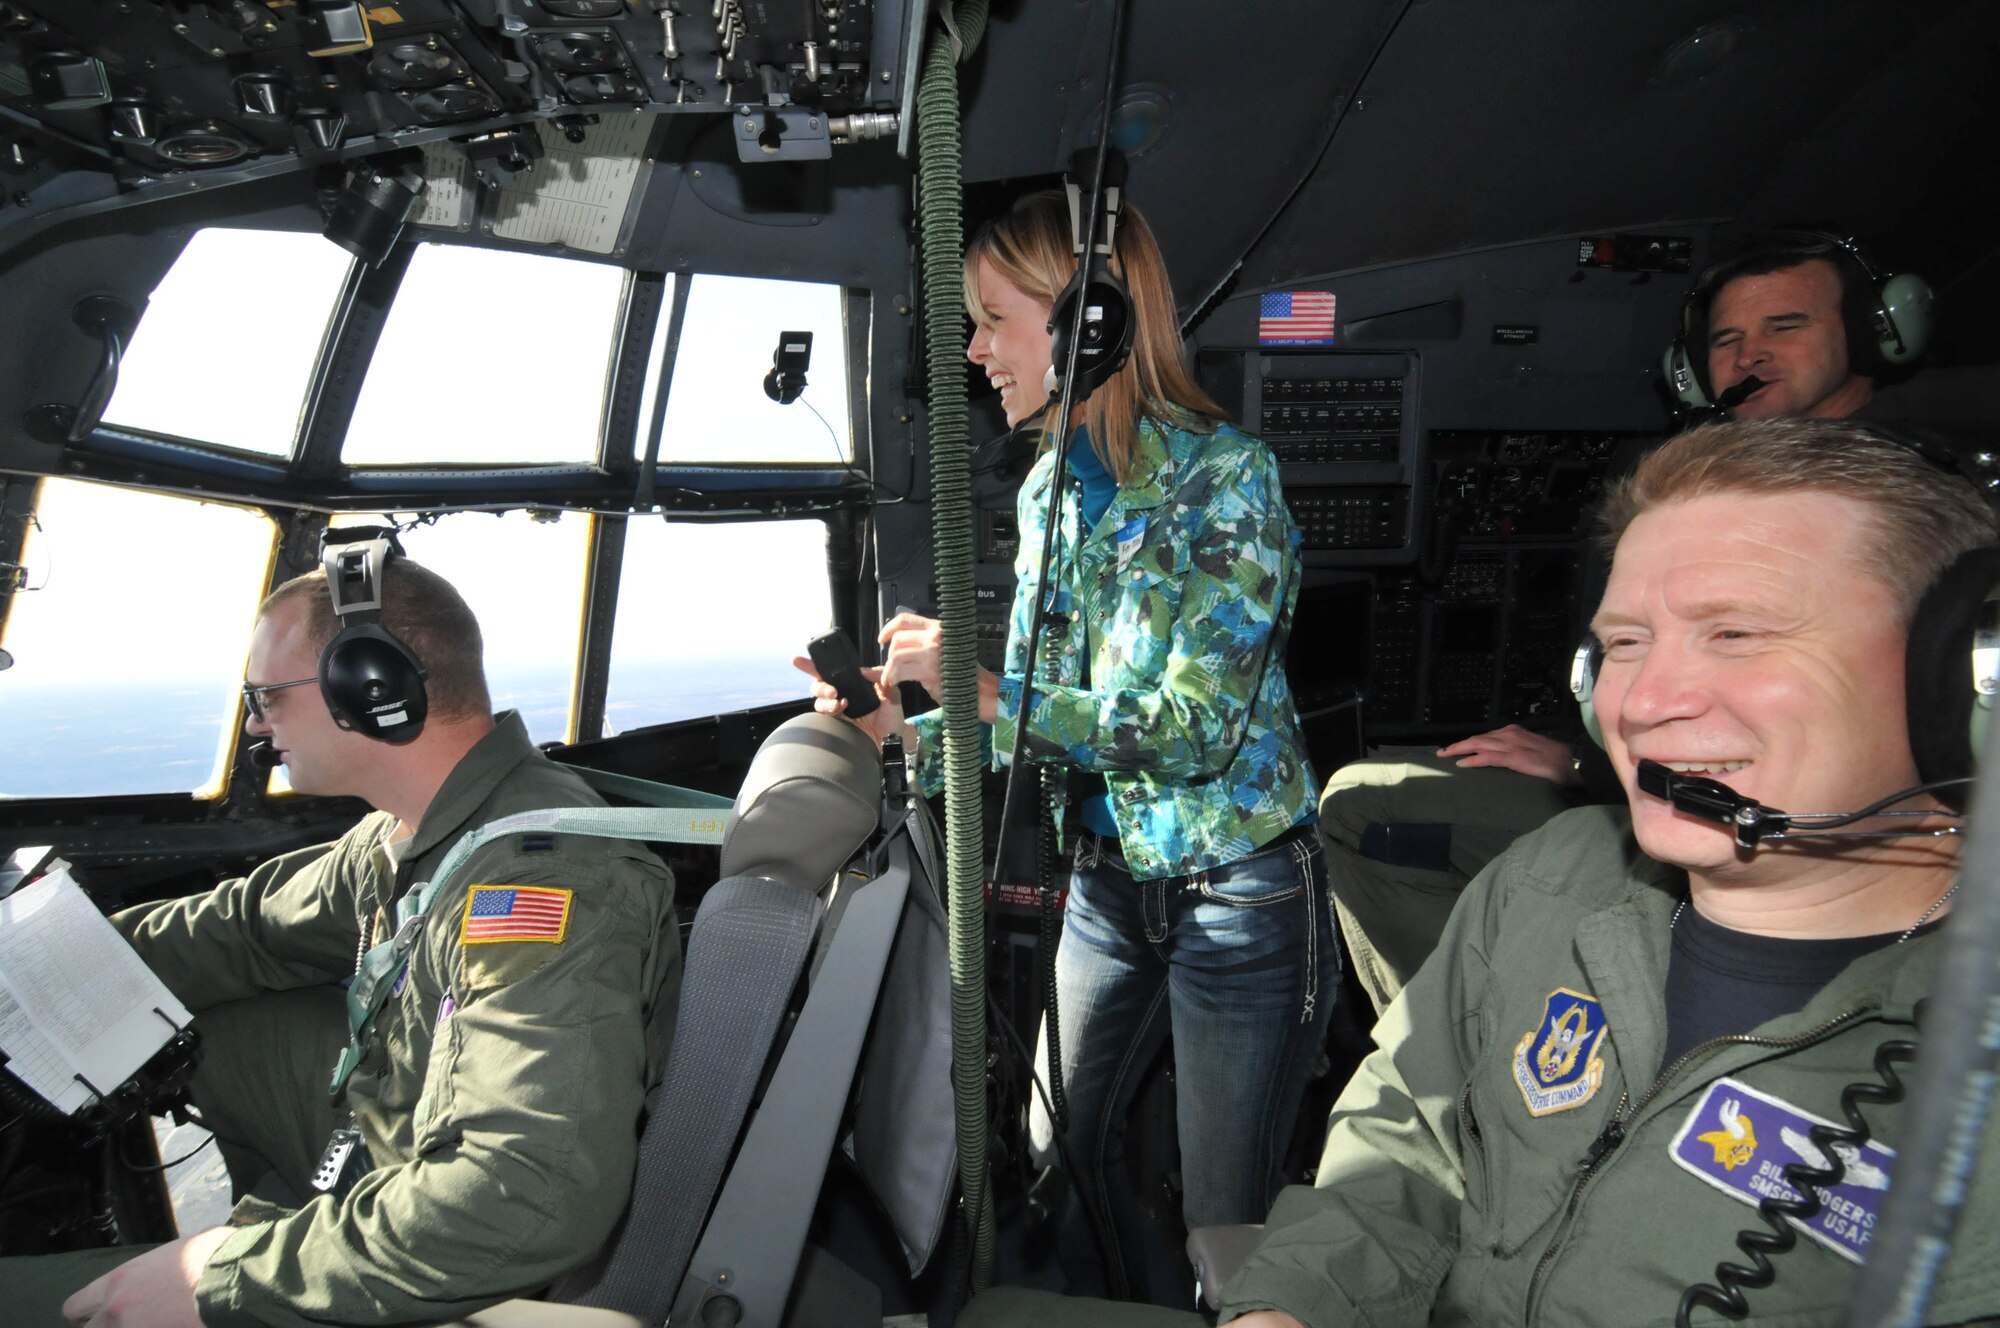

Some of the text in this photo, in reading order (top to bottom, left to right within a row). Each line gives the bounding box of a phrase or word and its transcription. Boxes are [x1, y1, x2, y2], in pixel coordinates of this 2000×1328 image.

[977, 590, 996, 598] BUS
[368, 699, 407, 713] BOSE
[1551, 1080, 1588, 1105] COMMAND
[1812, 1186, 1877, 1229] OGERS
[1823, 1212, 1874, 1246] USAF
